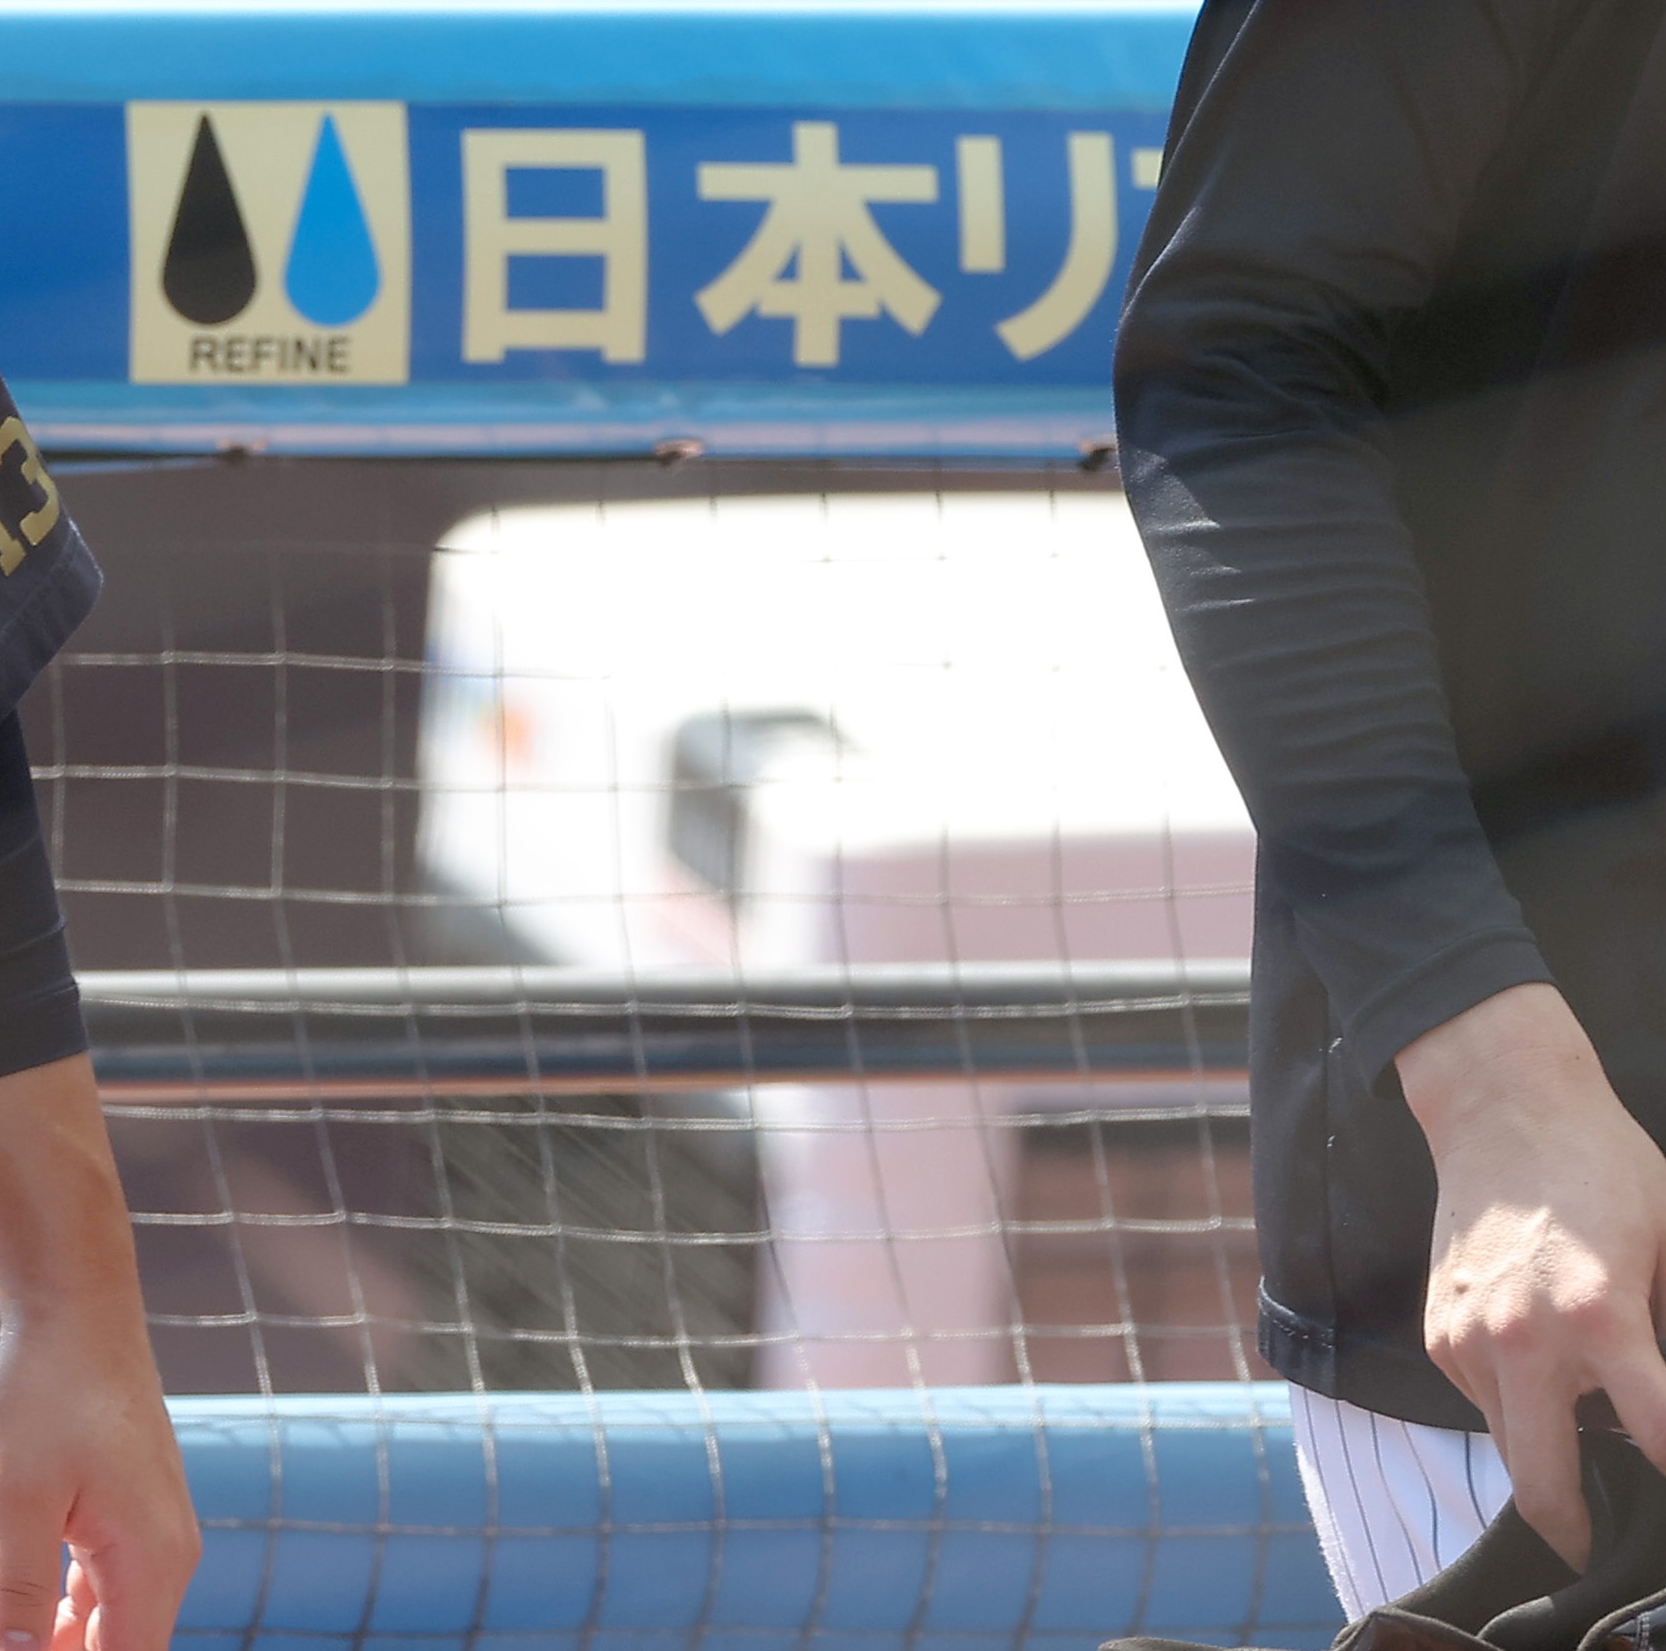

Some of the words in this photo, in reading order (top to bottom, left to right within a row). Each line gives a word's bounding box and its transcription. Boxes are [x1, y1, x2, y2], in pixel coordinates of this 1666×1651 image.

[461, 122, 1161, 366] 日本リ
[189, 334, 351, 373] REFINE
